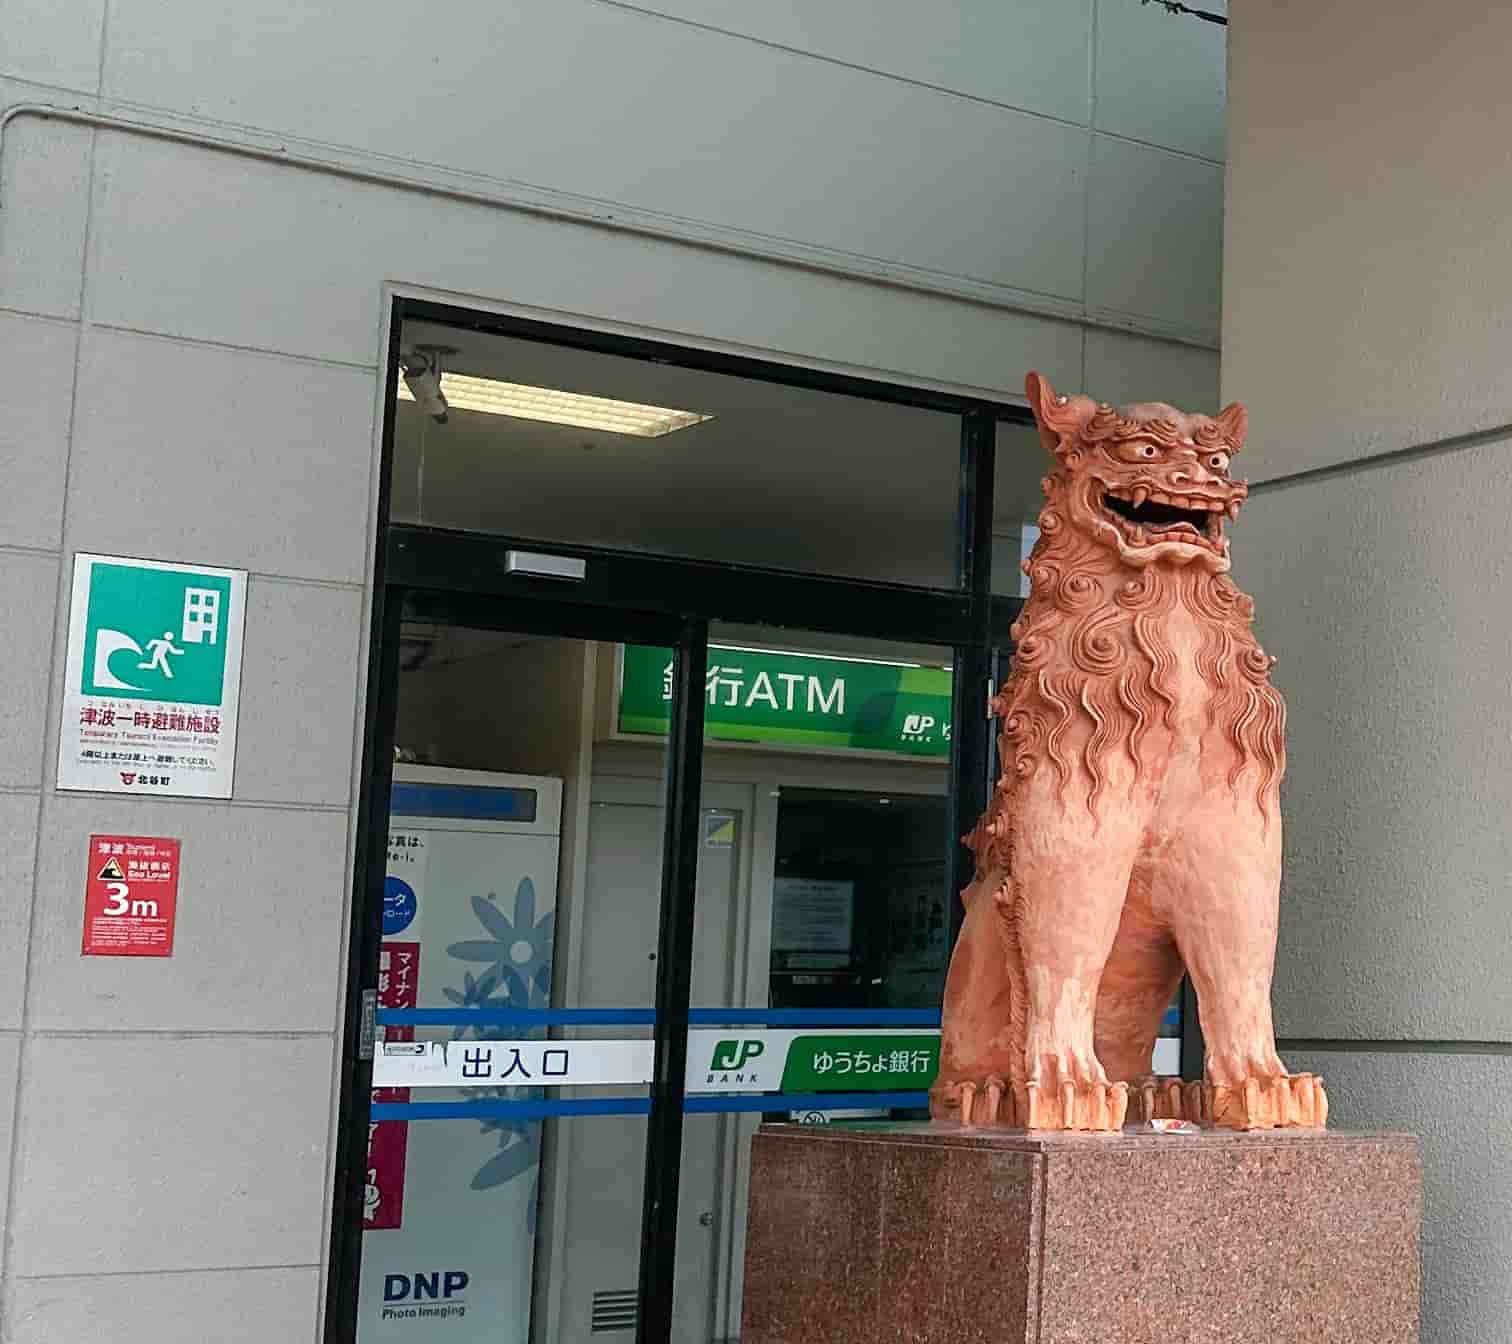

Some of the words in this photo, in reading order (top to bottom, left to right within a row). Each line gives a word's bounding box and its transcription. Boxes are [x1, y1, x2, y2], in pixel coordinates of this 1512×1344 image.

[80, 707, 220, 734] 津波一時避難施設
[103, 882, 158, 917] 3m
[462, 1047, 570, 1078] 出入口
[710, 1040, 765, 1071] JP
[813, 1050, 931, 1074] ゆうちょ銀行
[706, 1073, 759, 1084] BANK
[383, 1271, 470, 1301] DNP
[382, 1307, 417, 1320] Photo
[418, 1305, 465, 1319] Imaging
